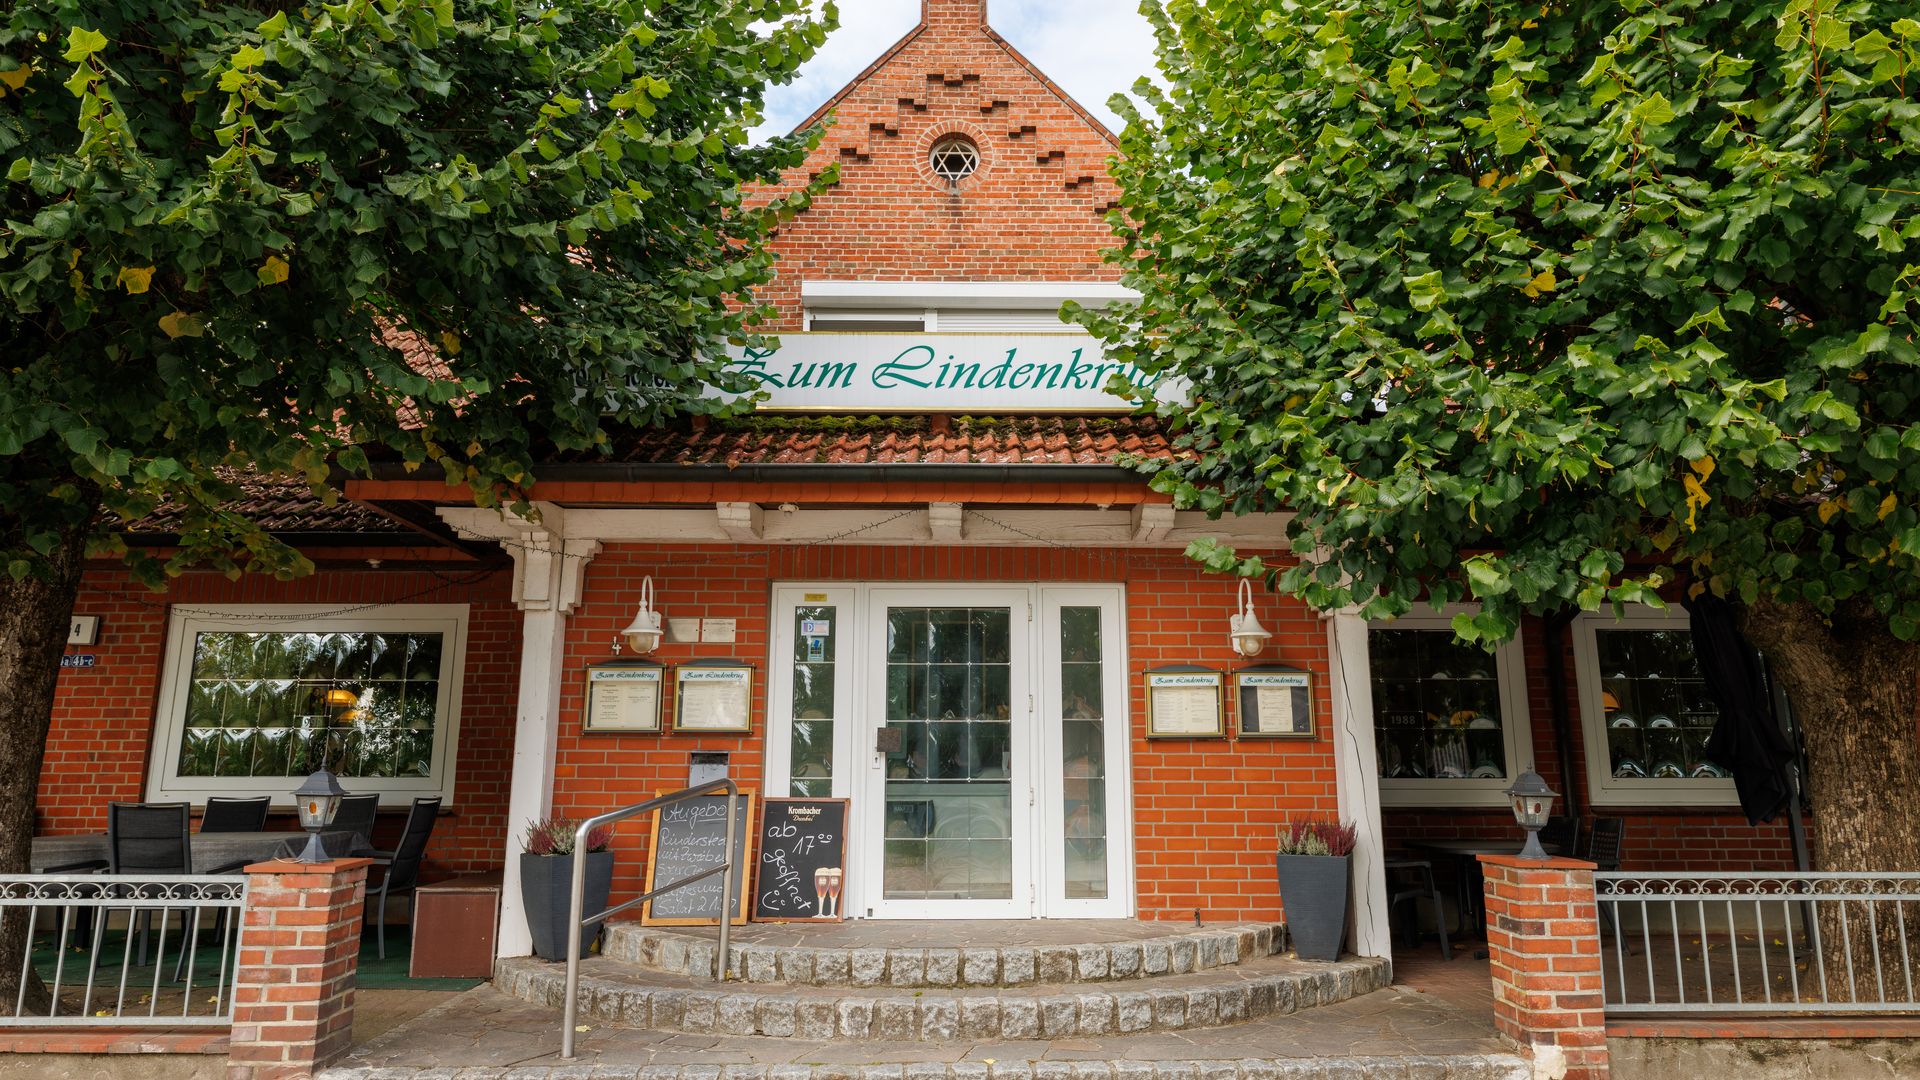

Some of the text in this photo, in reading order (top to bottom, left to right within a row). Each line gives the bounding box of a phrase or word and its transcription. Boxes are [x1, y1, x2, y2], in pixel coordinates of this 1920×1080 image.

[720, 345, 857, 394] Zum
[74, 624, 81, 636] 4
[611, 636, 622, 655] 4
[595, 671, 656, 680] Zum Lindenkrug
[684, 671, 745, 680] Zum Lindenkrug
[1155, 676, 1215, 685] Zum Lindenkrug
[1244, 676, 1304, 685] Zum Lindenkrug
[1391, 715, 1416, 725] 1988
[788, 806, 822, 815] Krombacher
[768, 821, 797, 838] ab
